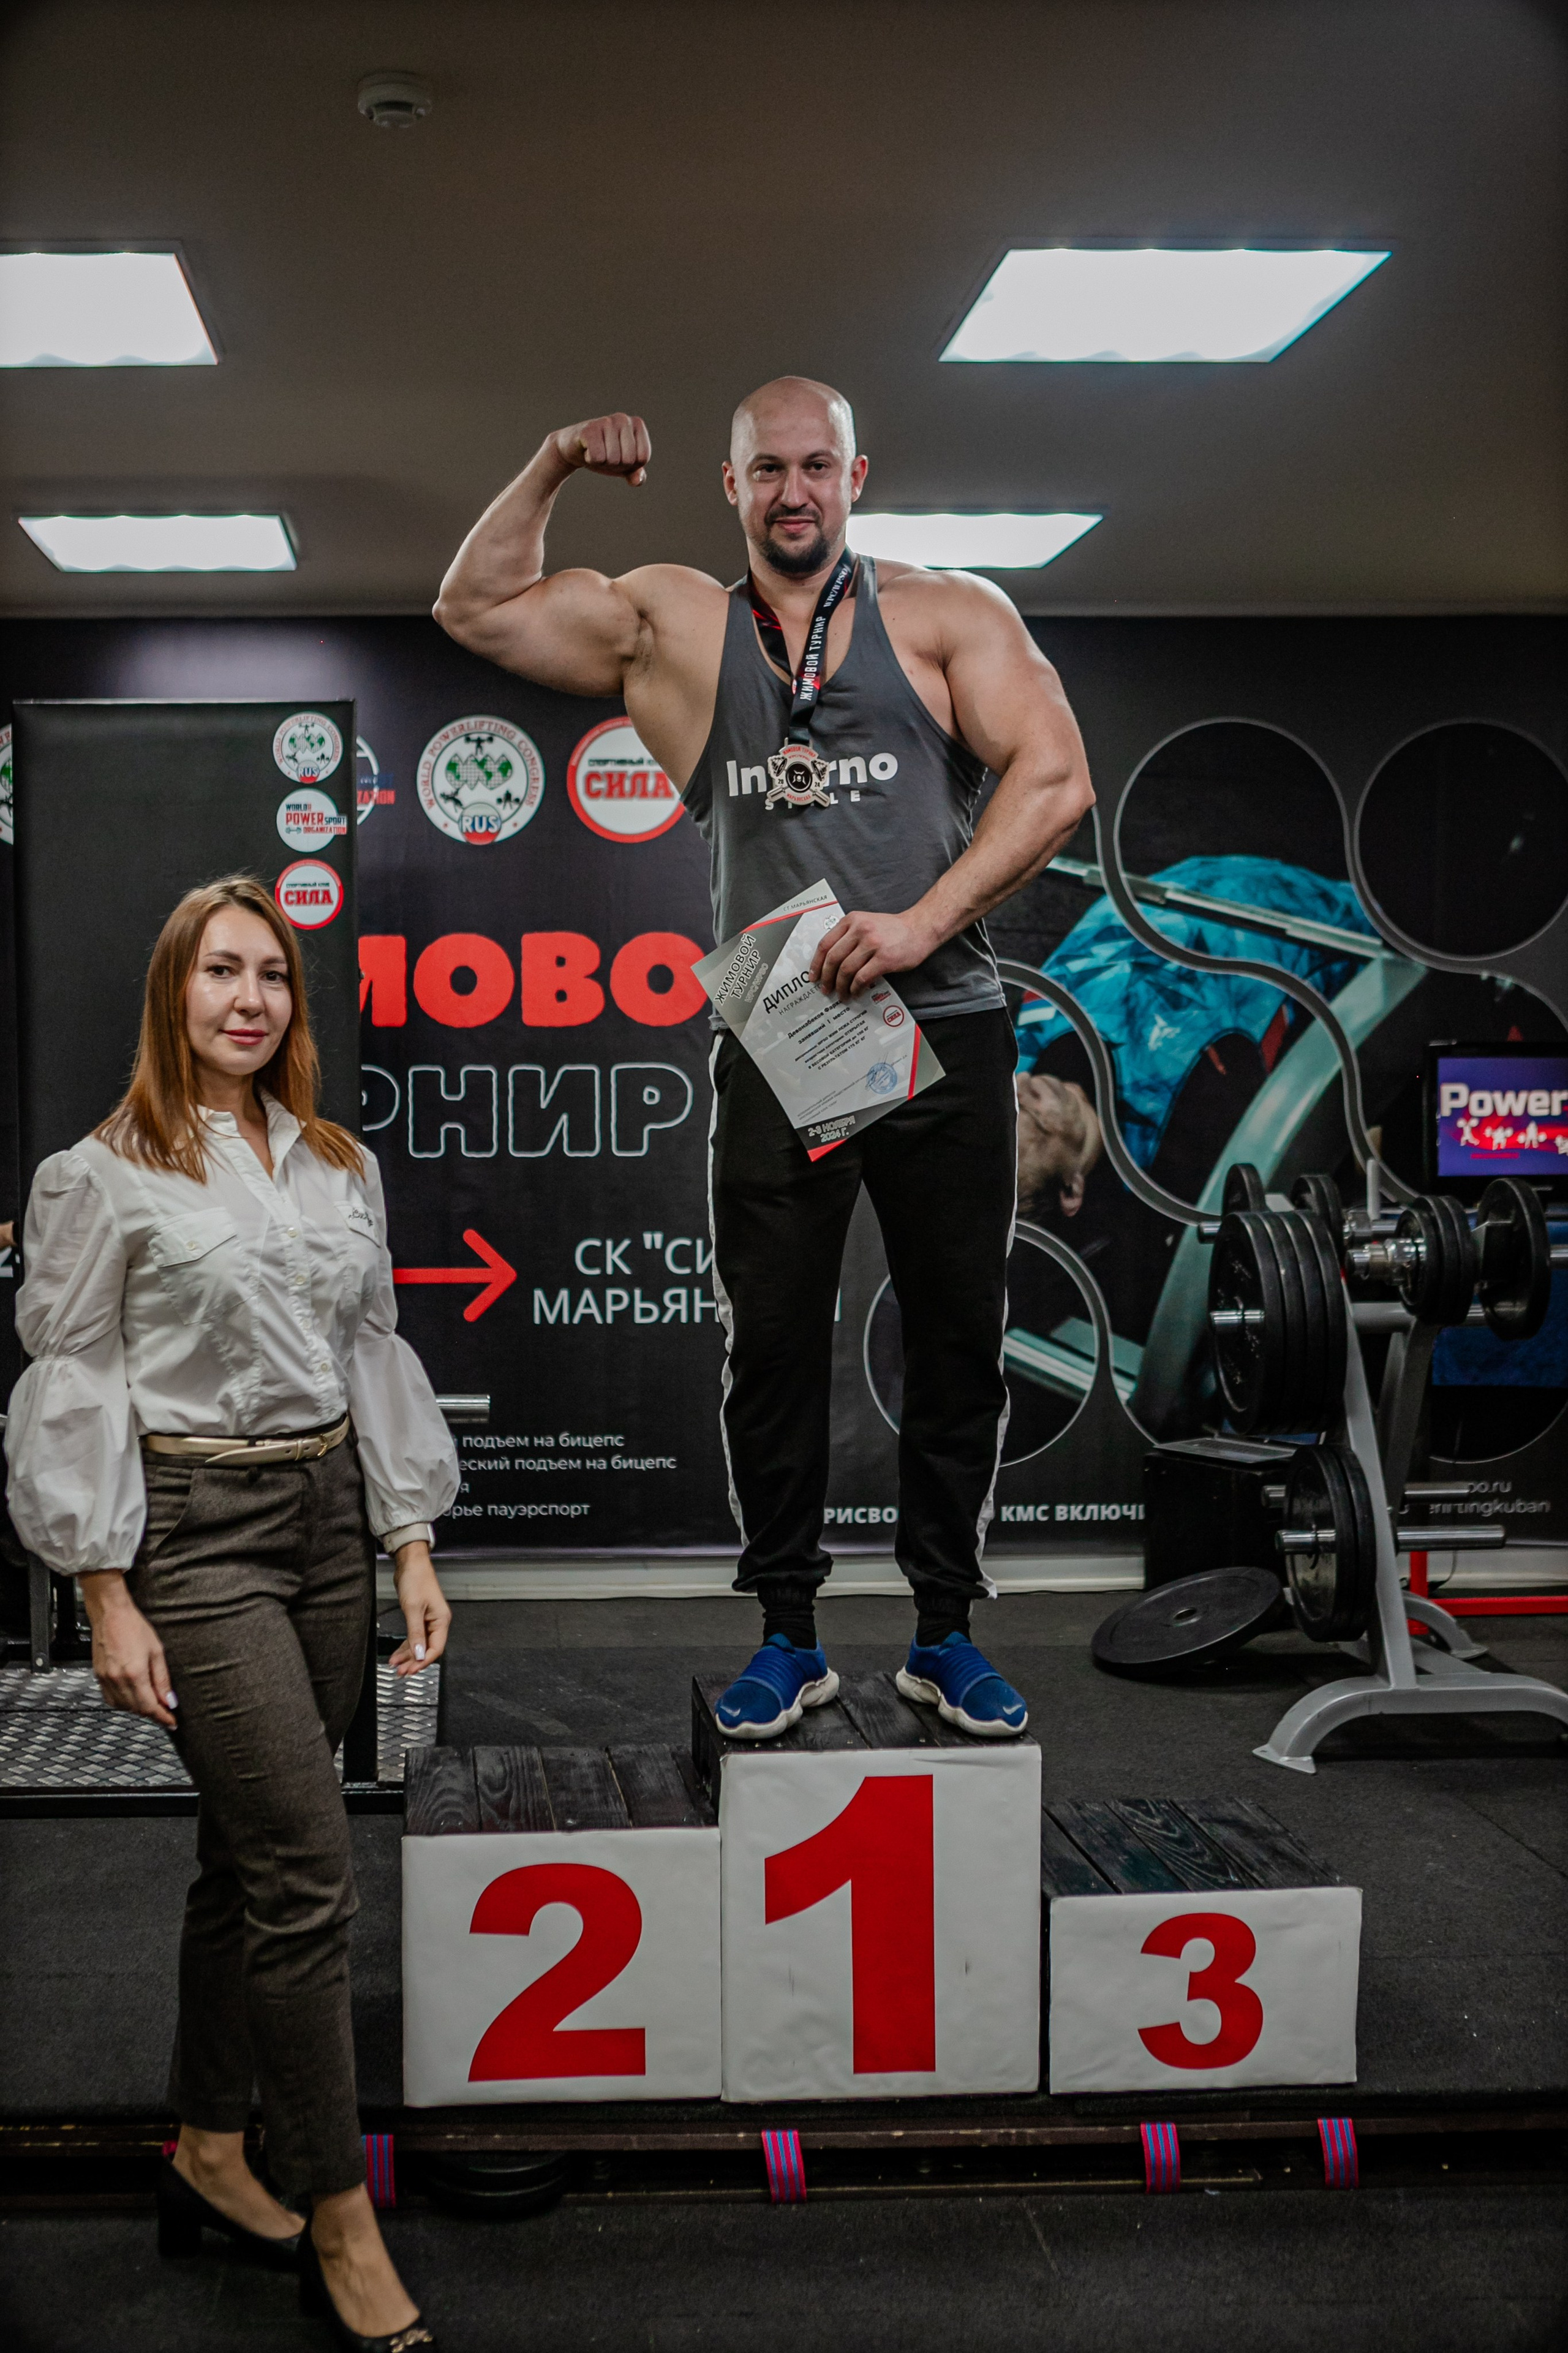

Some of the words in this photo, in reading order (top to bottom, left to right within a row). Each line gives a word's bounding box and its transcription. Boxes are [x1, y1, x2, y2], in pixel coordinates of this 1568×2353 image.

[809, 616, 826, 651] ТУРНИР
[800, 654, 820, 701] ЖИМОВОЙ
[297, 767, 318, 777] RUS
[421, 761, 435, 809] WORLD
[428, 720, 516, 756] POWERLIFTING
[517, 740, 539, 807] CONGRESS
[726, 752, 899, 796] Inrno
[584, 771, 674, 799] СИЛА
[285, 812, 324, 825] POWER
[462, 816, 499, 834] RUS
[285, 890, 333, 905] СИЛА
[714, 933, 756, 1005] ЖИМОВОЙ
[730, 950, 761, 999] ТУРНИР
[832, 1007, 850, 1020] место
[575, 1239, 632, 1275] СК
[462, 1434, 529, 1449] подъем
[534, 1437, 554, 1448] на
[558, 1431, 625, 1449] бицепс
[514, 1457, 582, 1472] подъем
[586, 1459, 607, 1470] на
[611, 1453, 677, 1471] бицепс
[488, 1502, 590, 1519] пауэрспорт
[1000, 1505, 1050, 1522] КМС
[763, 1773, 937, 2074] 1
[467, 1862, 647, 2083] 2
[1138, 1911, 1265, 2070] 3
